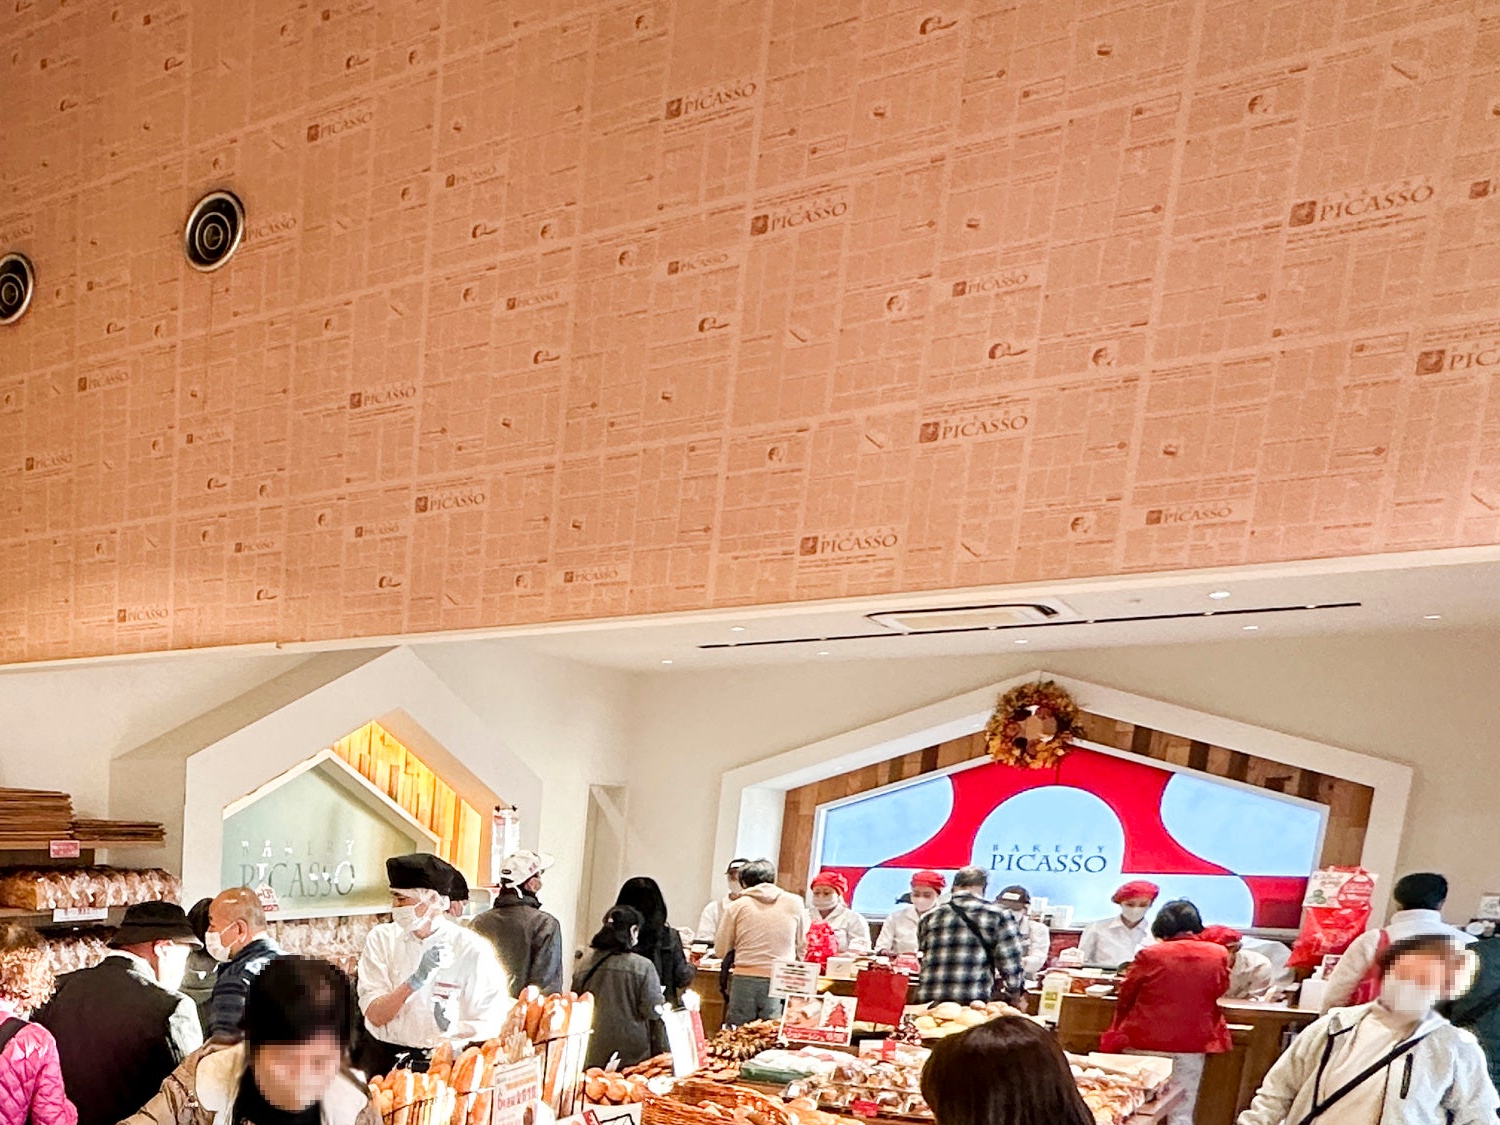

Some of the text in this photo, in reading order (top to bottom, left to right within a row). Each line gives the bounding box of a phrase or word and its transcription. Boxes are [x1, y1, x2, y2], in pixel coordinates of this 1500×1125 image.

[1320, 185, 1433, 221] PICASSO
[772, 203, 847, 231] PICASSO
[968, 274, 1028, 294] PICASSO
[943, 415, 1028, 439] PICASSO
[430, 493, 485, 511] PICASSO
[1164, 507, 1232, 523] PICASSO
[821, 534, 897, 553] PICASSO
[992, 844, 1105, 853] BAKERY
[990, 853, 1107, 873] PICASSO
